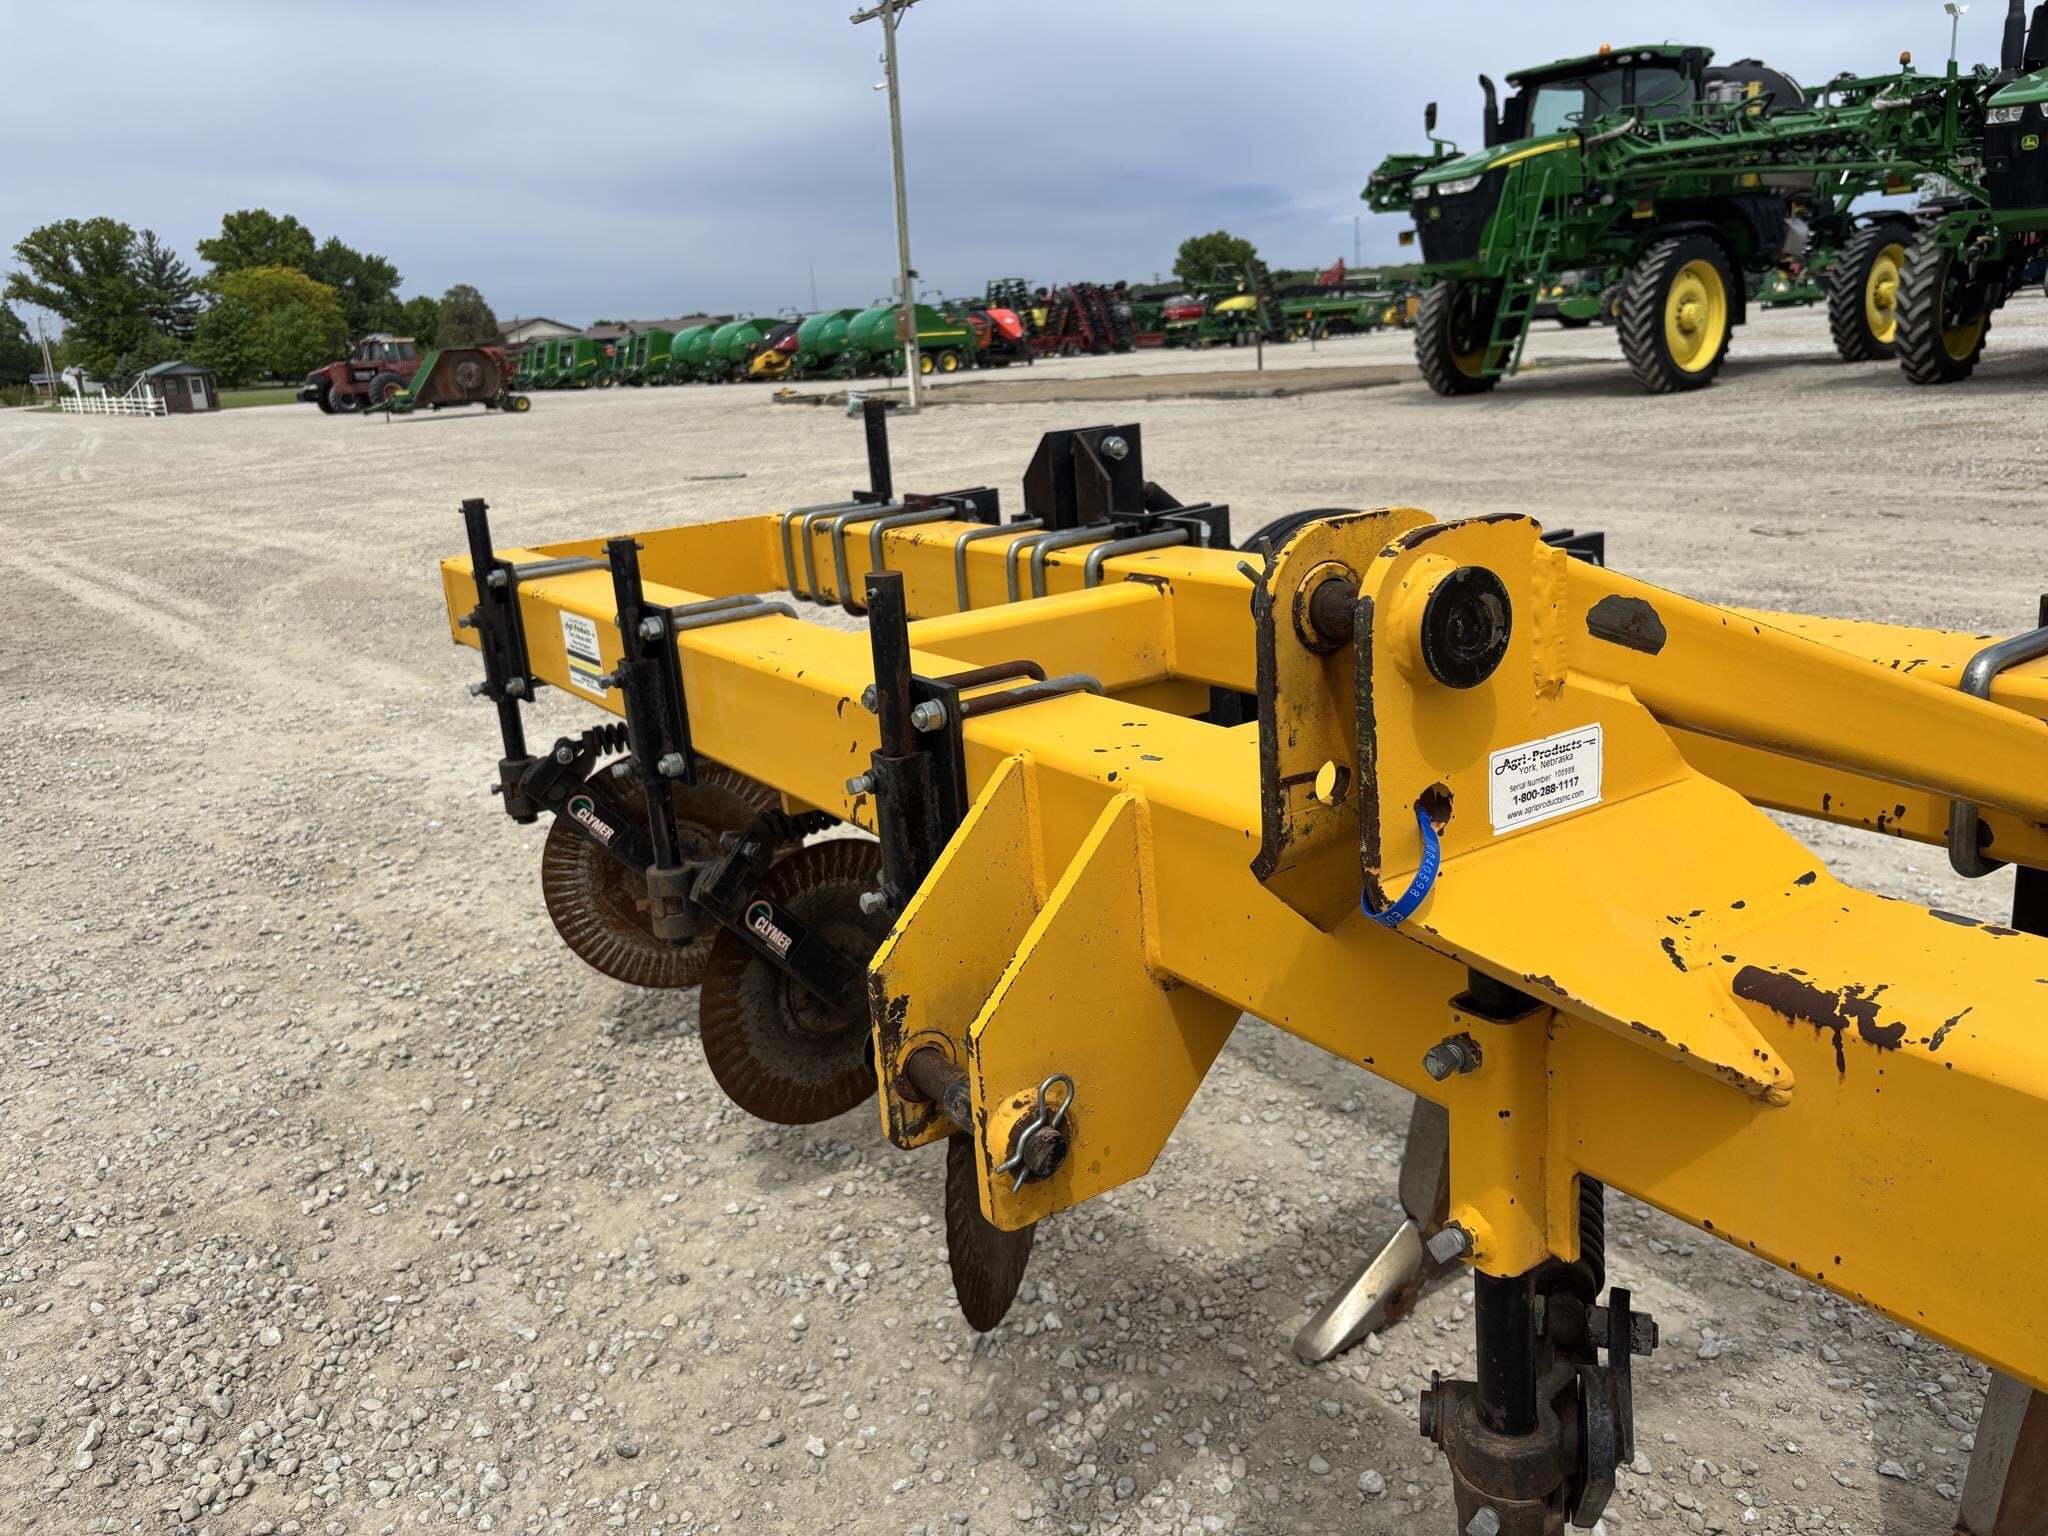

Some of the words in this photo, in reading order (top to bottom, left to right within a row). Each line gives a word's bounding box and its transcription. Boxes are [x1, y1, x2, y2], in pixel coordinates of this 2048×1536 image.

[1495, 740, 1582, 775] Agri-Products
[1519, 764, 1538, 775] York,
[1540, 752, 1574, 769] Nebraska
[1509, 781, 1526, 792] Serial
[1527, 775, 1551, 787] Number
[1512, 776, 1579, 805] 1-800-288-1117
[576, 807, 615, 840] CLYMER
[754, 915, 793, 951] CLYMER
